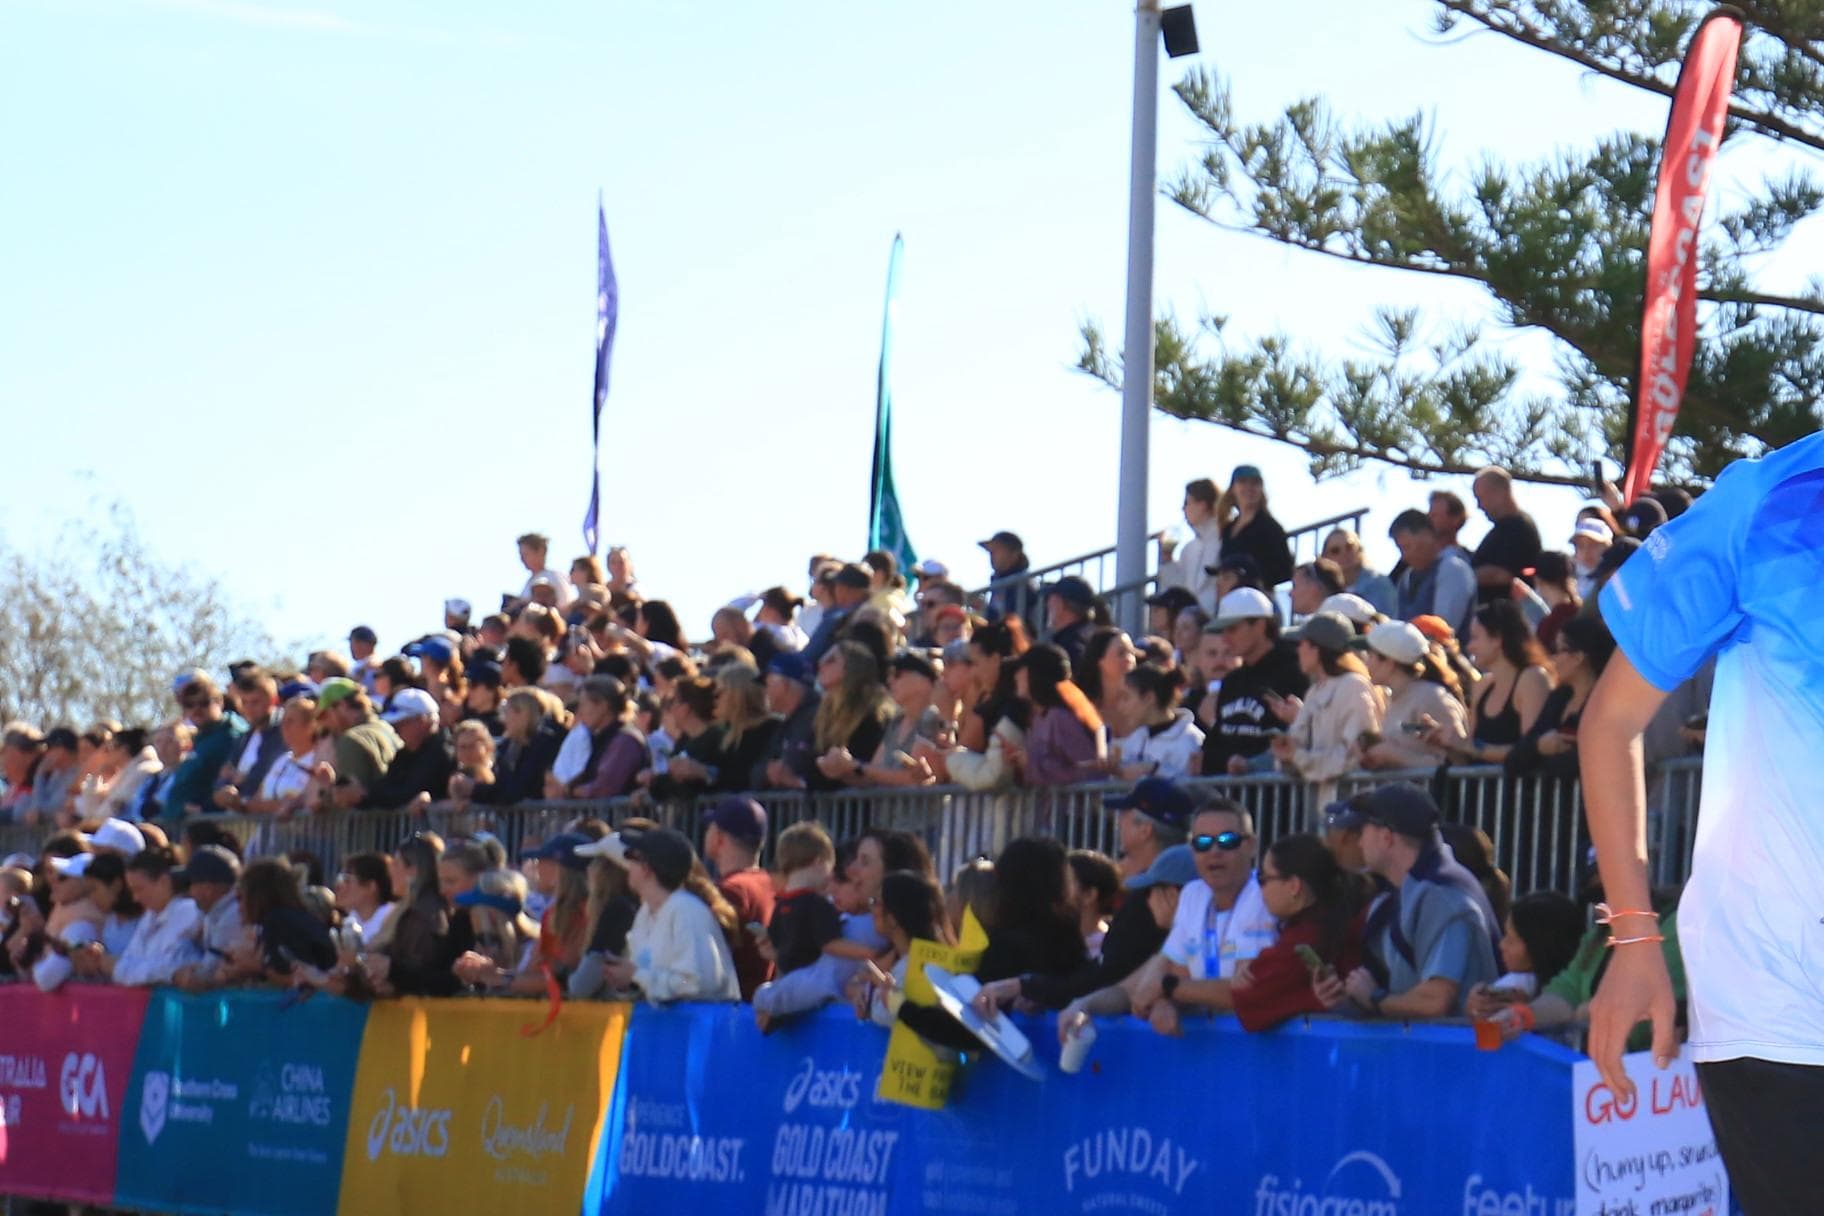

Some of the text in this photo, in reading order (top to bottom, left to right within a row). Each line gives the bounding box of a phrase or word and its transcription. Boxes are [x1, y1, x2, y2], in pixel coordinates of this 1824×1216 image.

[59, 1050, 110, 1120] GCA
[1585, 1073, 1707, 1125] GO LAU
[772, 1124, 899, 1184] GOLD COAST
[1063, 1127, 1198, 1195] FUNDAY
